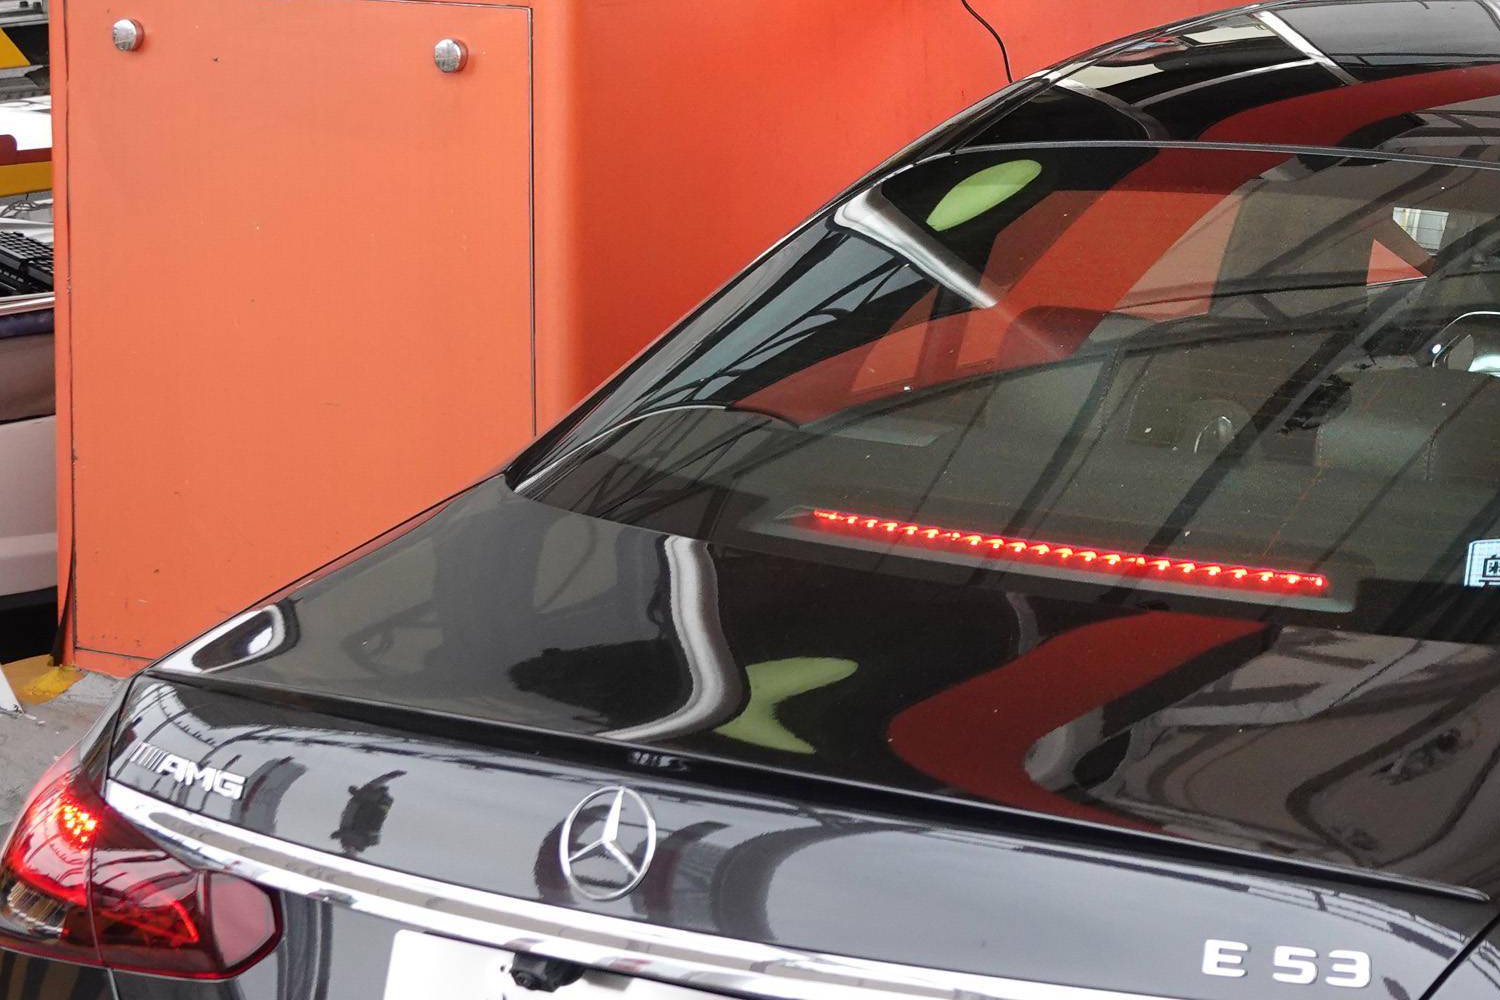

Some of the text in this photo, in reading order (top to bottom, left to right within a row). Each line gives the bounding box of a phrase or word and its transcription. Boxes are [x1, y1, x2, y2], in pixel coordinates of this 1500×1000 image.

[157, 753, 246, 800] AMG
[1202, 938, 1372, 989] E 53
